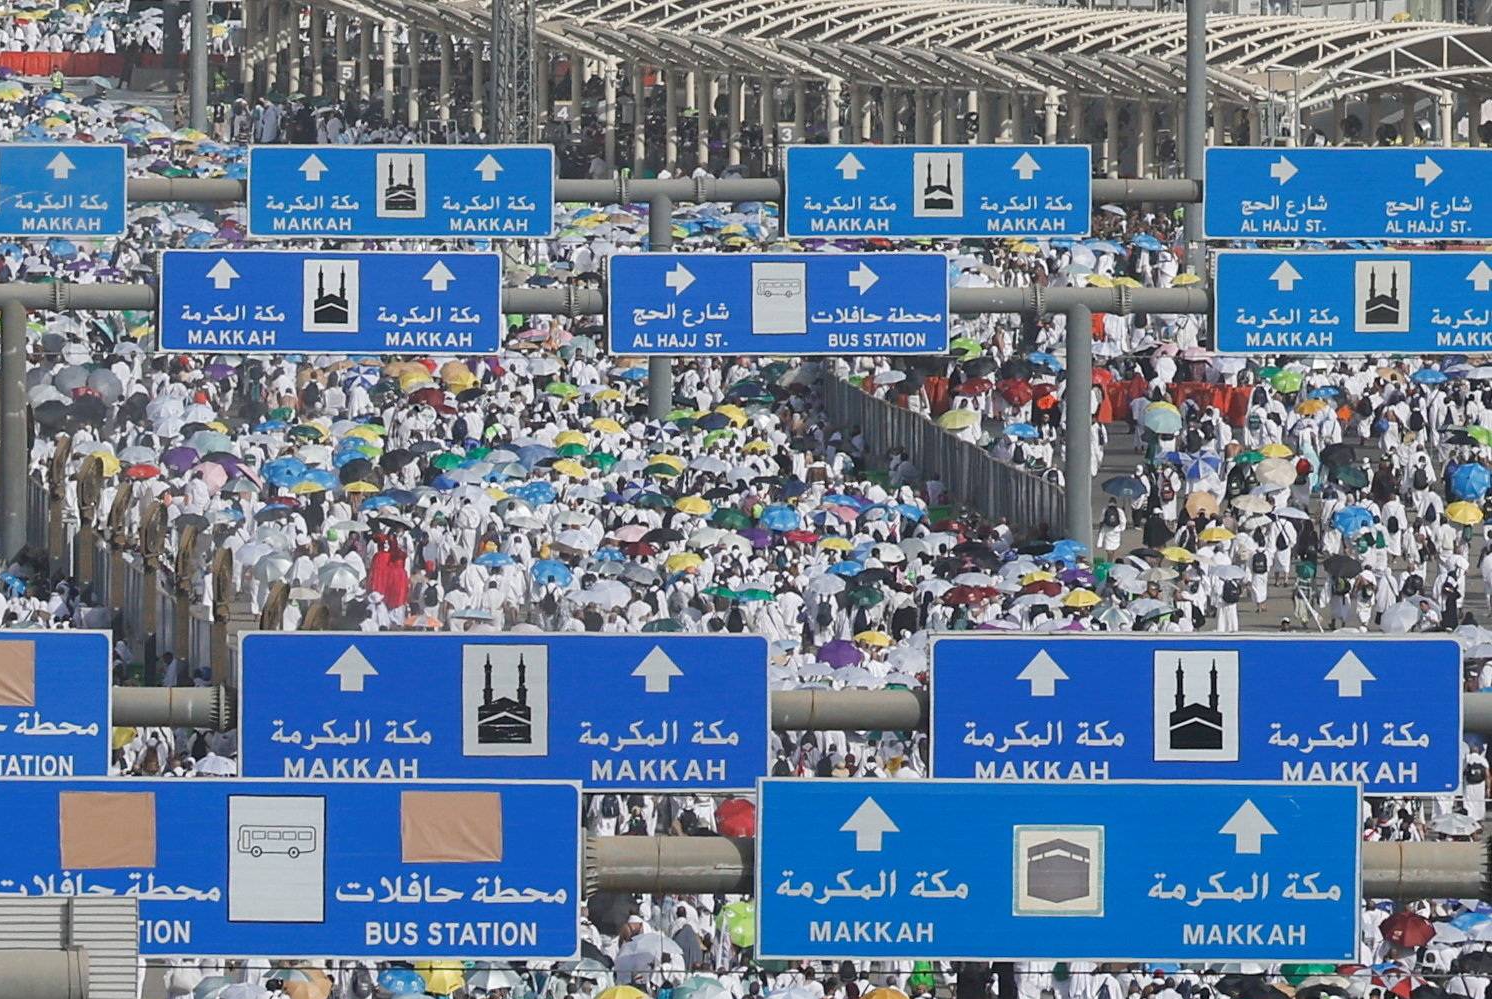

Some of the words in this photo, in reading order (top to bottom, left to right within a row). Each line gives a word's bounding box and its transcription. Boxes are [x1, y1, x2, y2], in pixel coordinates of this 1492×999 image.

[781, 128, 792, 142] 3
[265, 195, 324, 214] المكرمة
[330, 194, 360, 210] مكة
[442, 195, 500, 215] المكرمة
[507, 195, 536, 212] مكة
[803, 195, 862, 215] المكرمة
[868, 195, 897, 212] مكة
[980, 195, 1038, 215] المكرمة
[1044, 195, 1073, 211] مكة
[1241, 194, 1280, 216] الحج
[1285, 194, 1328, 218] شارع
[1385, 196, 1424, 217] الحج
[1430, 195, 1473, 219] شارع
[22, 216, 101, 232] MAKKAH
[273, 217, 352, 231] MAKKAH
[449, 217, 528, 232] MAKKAH
[810, 217, 889, 232] MAKKAH
[987, 217, 1066, 232] MAKKAH
[1240, 219, 1259, 233] AL
[1262, 219, 1299, 233] HAJJ
[1305, 218, 1327, 233] ST.
[1385, 220, 1404, 234] AL
[1407, 219, 1444, 234] HAJJ
[1450, 219, 1472, 234] ST.
[180, 304, 246, 325] المكرمة
[253, 305, 286, 322] مكة
[376, 306, 442, 328] المكرمة
[449, 306, 481, 324] مكة
[632, 303, 676, 327] الحج
[682, 302, 730, 328] شارع
[810, 305, 883, 324] حافلات
[886, 307, 942, 323] محطة
[1235, 308, 1301, 329] المكرمة
[1308, 308, 1340, 325] مكة
[187, 329, 276, 346] MAKKAH
[385, 331, 472, 347] MAKKAH
[632, 333, 654, 348] AL
[657, 333, 697, 348] HAJJ
[704, 332, 728, 348] ST.
[828, 333, 859, 348] BUS
[863, 332, 926, 348] STATION
[1246, 331, 1333, 347] MAKKAH
[13, 711, 99, 737] محطة
[383, 719, 432, 745] مكة
[691, 719, 739, 746] مكة
[1076, 720, 1125, 748] مكة
[1381, 721, 1430, 748] مكة
[270, 719, 371, 751] المكرمة
[578, 719, 678, 753] المكرمة
[963, 720, 1063, 753] المكرمة
[1268, 721, 1369, 754] المكرمة
[283, 758, 419, 778] MAKKAH
[591, 759, 726, 782] MAKKAH
[975, 761, 1109, 779] MAKKAH
[1282, 762, 1418, 784] MAKKAH
[125, 872, 220, 902] محطة
[335, 872, 465, 903] حافلات
[471, 875, 568, 905] محطة
[776, 868, 897, 905] المكرمة
[909, 869, 969, 900] مكة
[1147, 871, 1269, 907] المكرمة
[1281, 872, 1342, 902] مكة
[365, 921, 419, 946] BUS
[427, 921, 537, 947] STATION
[809, 920, 934, 943] MAKKAH
[1183, 923, 1306, 946] MAKKAH
